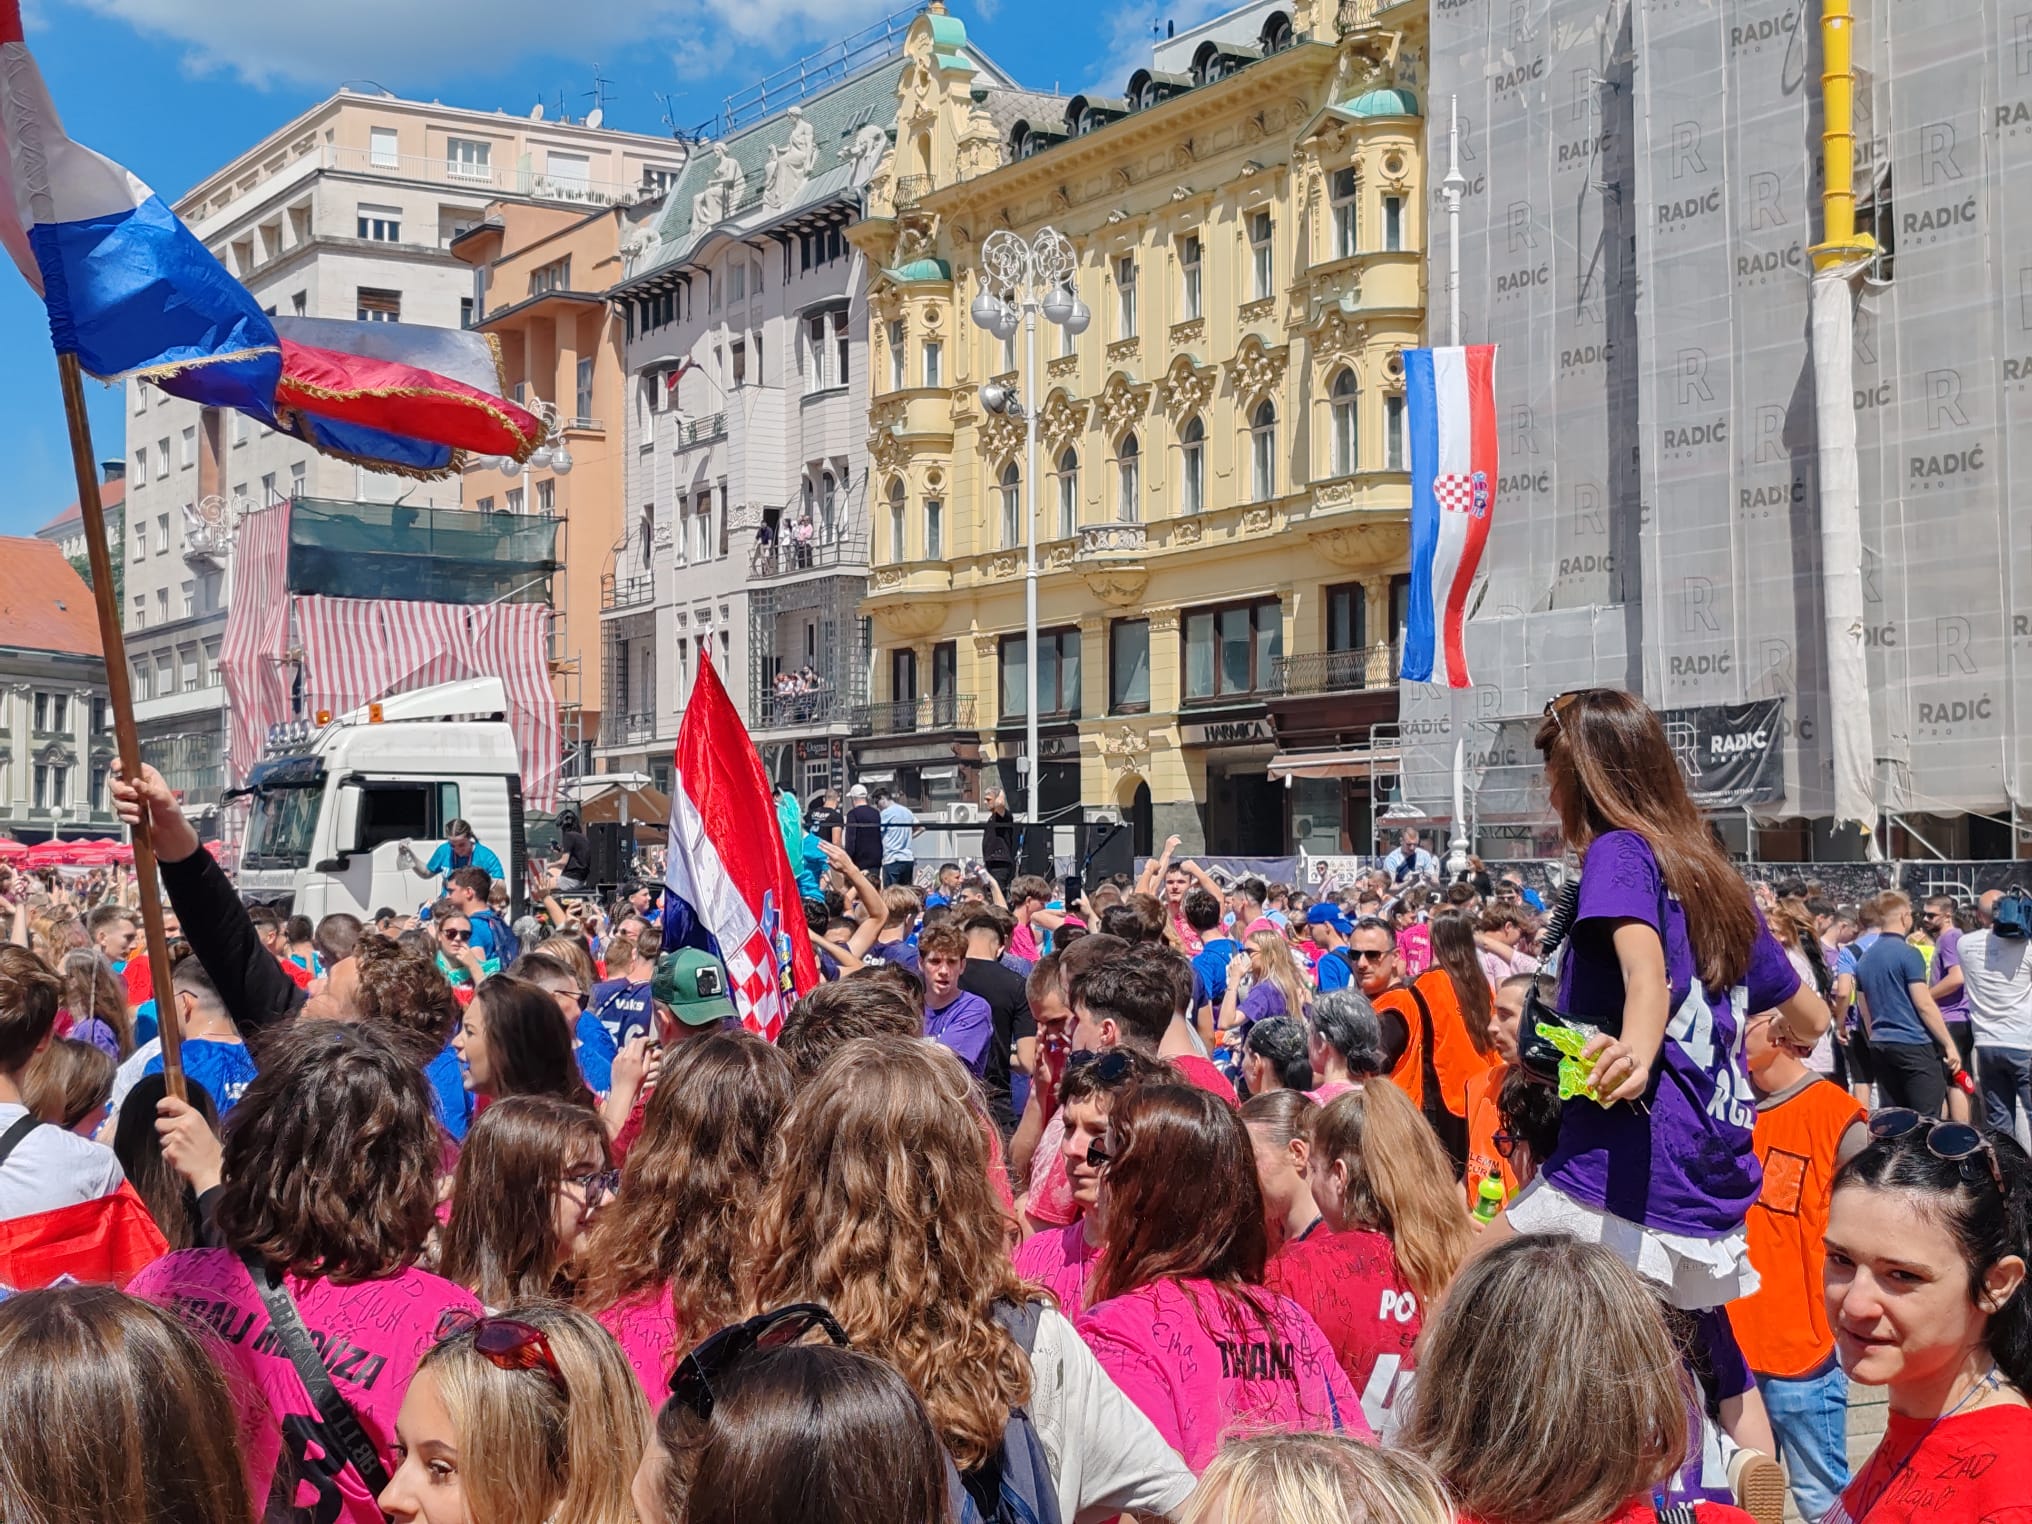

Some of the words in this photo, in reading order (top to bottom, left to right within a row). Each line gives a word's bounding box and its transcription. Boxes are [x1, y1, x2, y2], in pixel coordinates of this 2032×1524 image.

[1731, 8, 1795, 47] RADIĆ
[1494, 56, 1543, 94] RADIĆ
[1658, 186, 1720, 224] RADIĆ
[1903, 194, 1977, 235] RADIĆ
[1737, 240, 1801, 276] RADIĆ
[1497, 262, 1550, 293] RADIĆ
[1560, 340, 1616, 369] RADIĆ
[1663, 417, 1728, 449] RADIĆ
[1909, 442, 1984, 478] RADIĆ
[1560, 550, 1616, 576] RADIĆ
[1669, 650, 1732, 677] RADIĆ
[1918, 692, 1992, 725] RADIĆ
[1204, 721, 1265, 741] HARMICA
